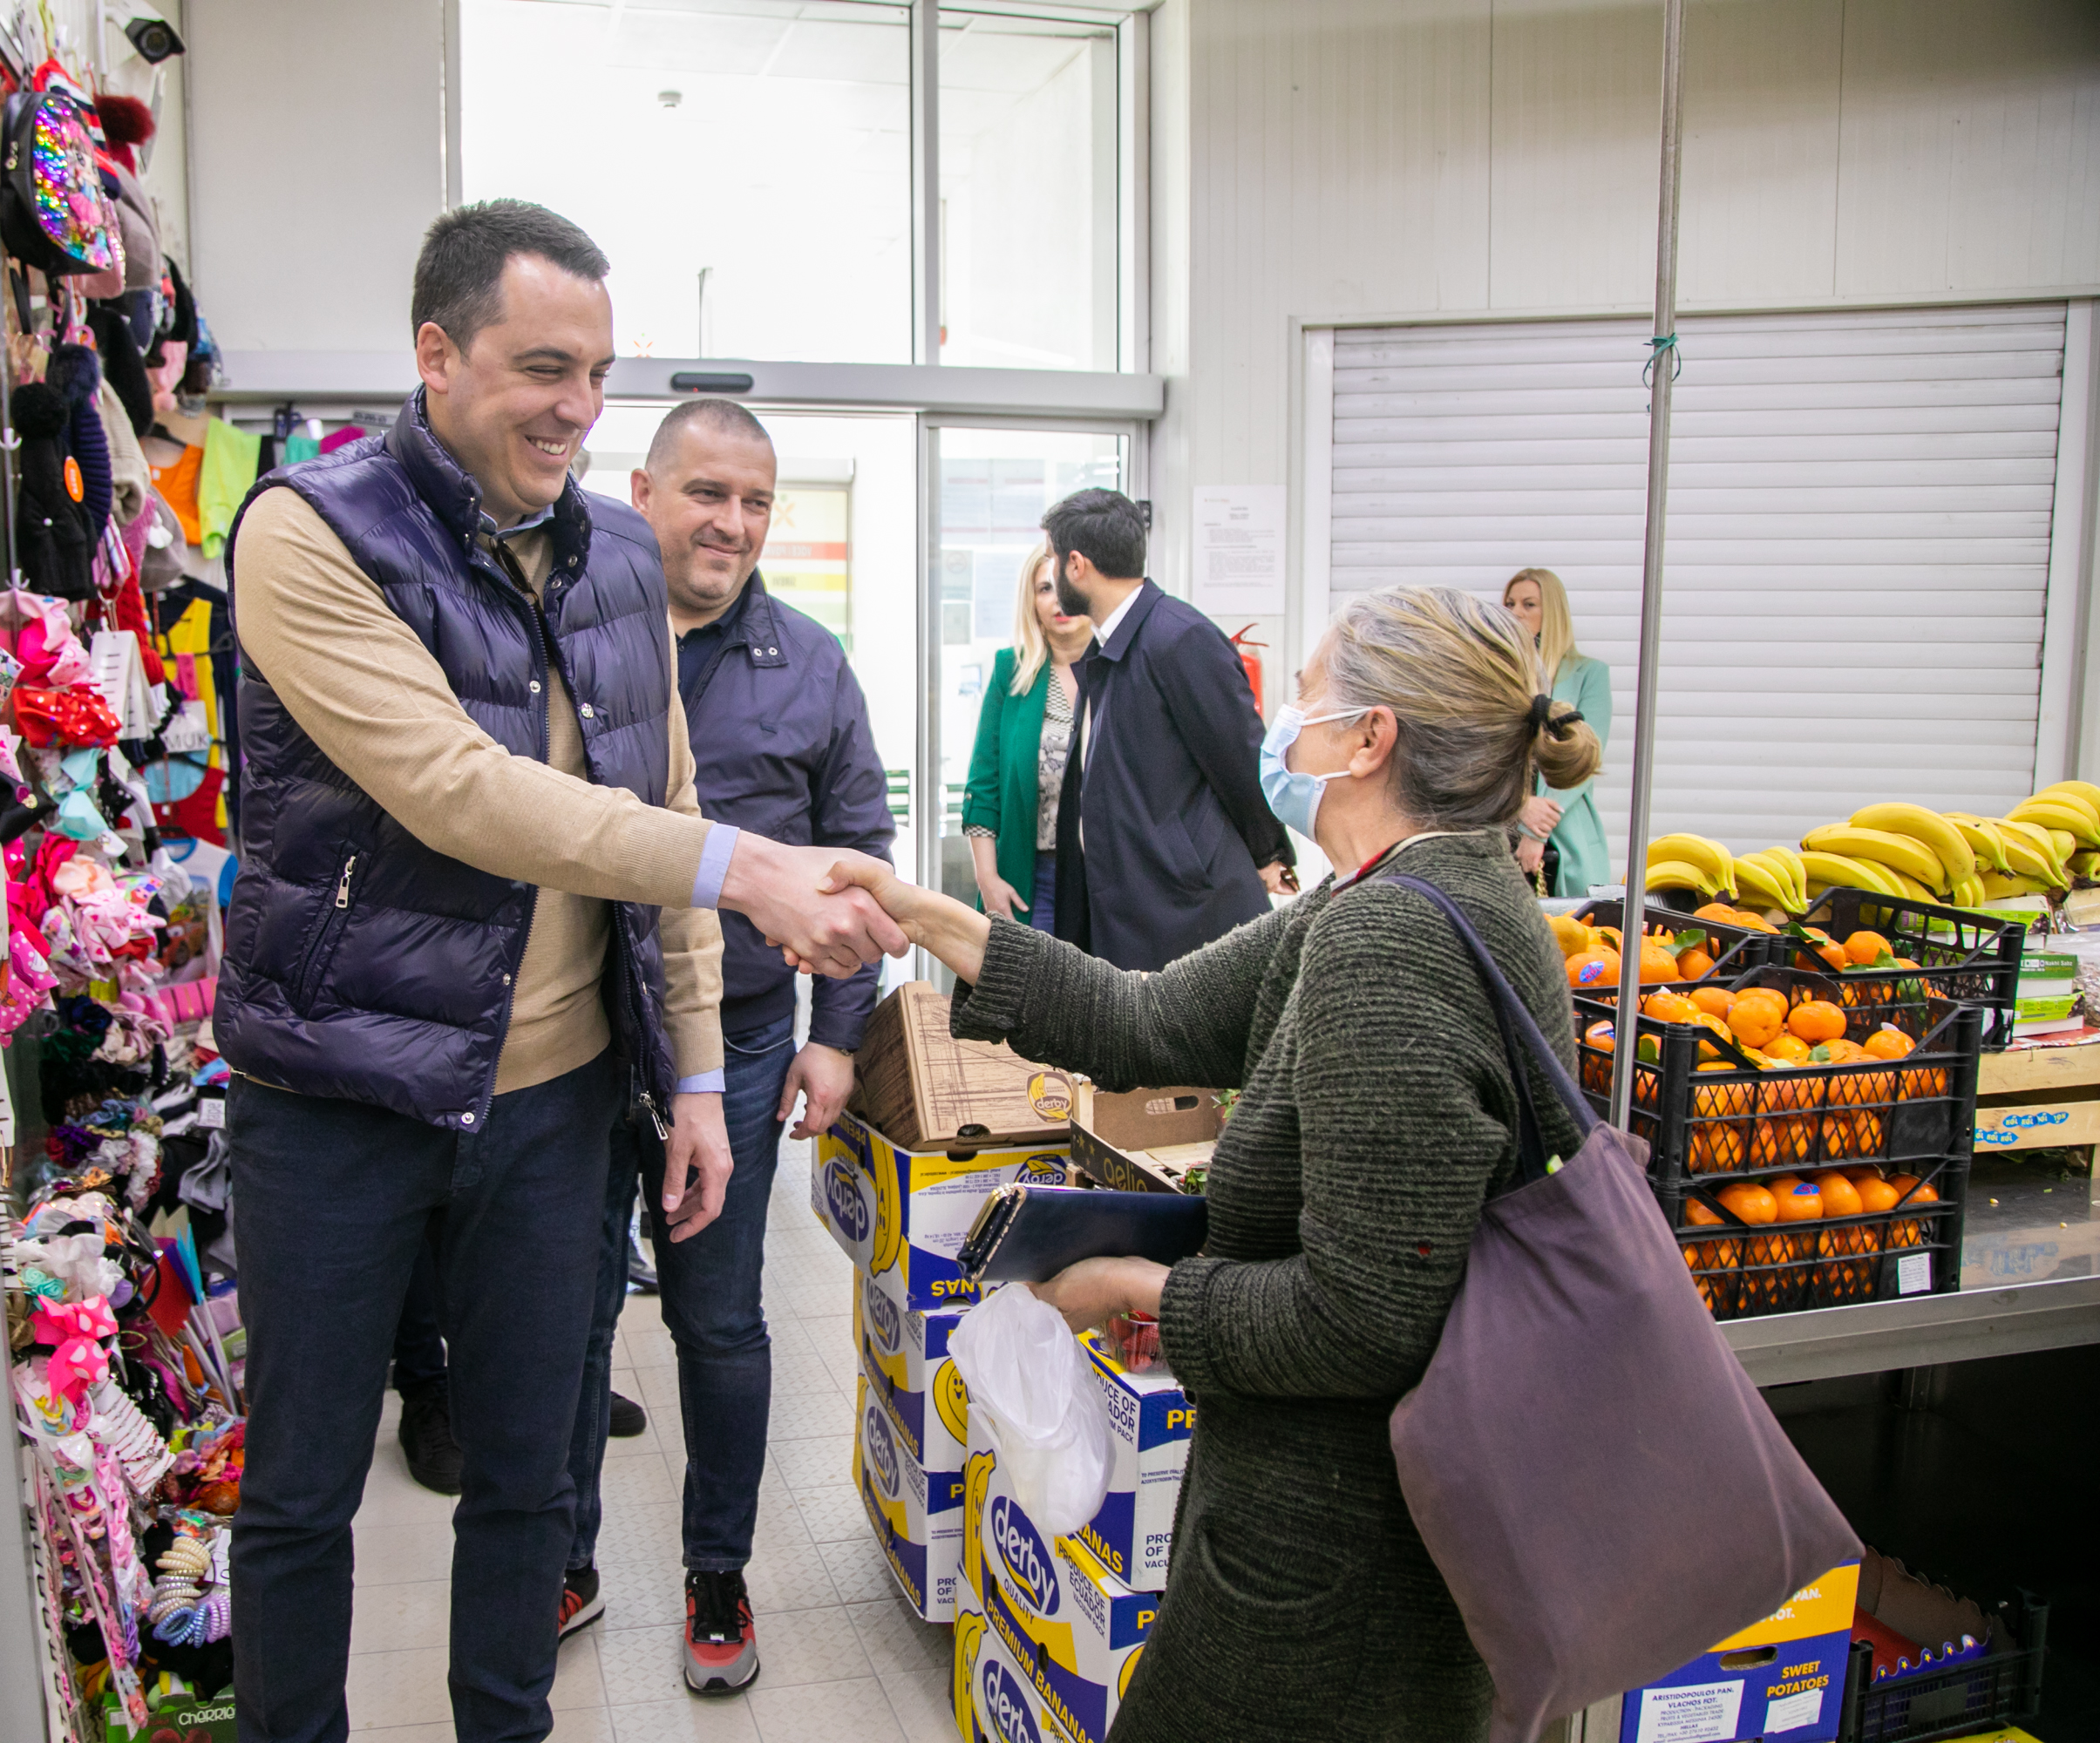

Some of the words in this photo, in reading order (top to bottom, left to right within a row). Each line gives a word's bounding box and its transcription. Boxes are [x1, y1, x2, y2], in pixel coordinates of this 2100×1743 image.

[1036, 1096, 1068, 1111] derby
[827, 1163, 866, 1242] derby
[867, 1278, 898, 1352] derby
[1108, 1400, 1135, 1434] ADOR
[1122, 1395, 1137, 1415] OF
[887, 1397, 919, 1458] BANANAS
[1117, 1425, 1134, 1446] PACK
[867, 1407, 897, 1497] derby
[995, 1497, 1055, 1615] derby
[1080, 1523, 1124, 1574] ANAS
[1145, 1546, 1164, 1557] OF
[1146, 1534, 1172, 1545] PRO
[887, 1544, 921, 1607] BANANAS
[1058, 1541, 1093, 1597] PRODUCE
[1094, 1590, 1105, 1611] OF
[1145, 1558, 1170, 1569] VACU
[937, 1587, 952, 1597] OF
[937, 1597, 955, 1605] VACU
[1004, 1578, 1035, 1624] QUALITY
[1070, 1570, 1105, 1630] ECUADOR
[1792, 1587, 1822, 1603] PAN.
[1072, 1590, 1092, 1622] VACUUM
[1092, 1618, 1105, 1640] PACK
[987, 1597, 1035, 1678] PREMIUM
[1766, 1674, 1830, 1698] POTATOES
[1782, 1660, 1821, 1679] SWEET
[987, 1663, 1034, 1743] derb
[1035, 1669, 1093, 1743] BANANA
[1652, 1689, 1716, 1701] ARISTIDOPOULOS
[1668, 1699, 1701, 1708] VLACHOS
